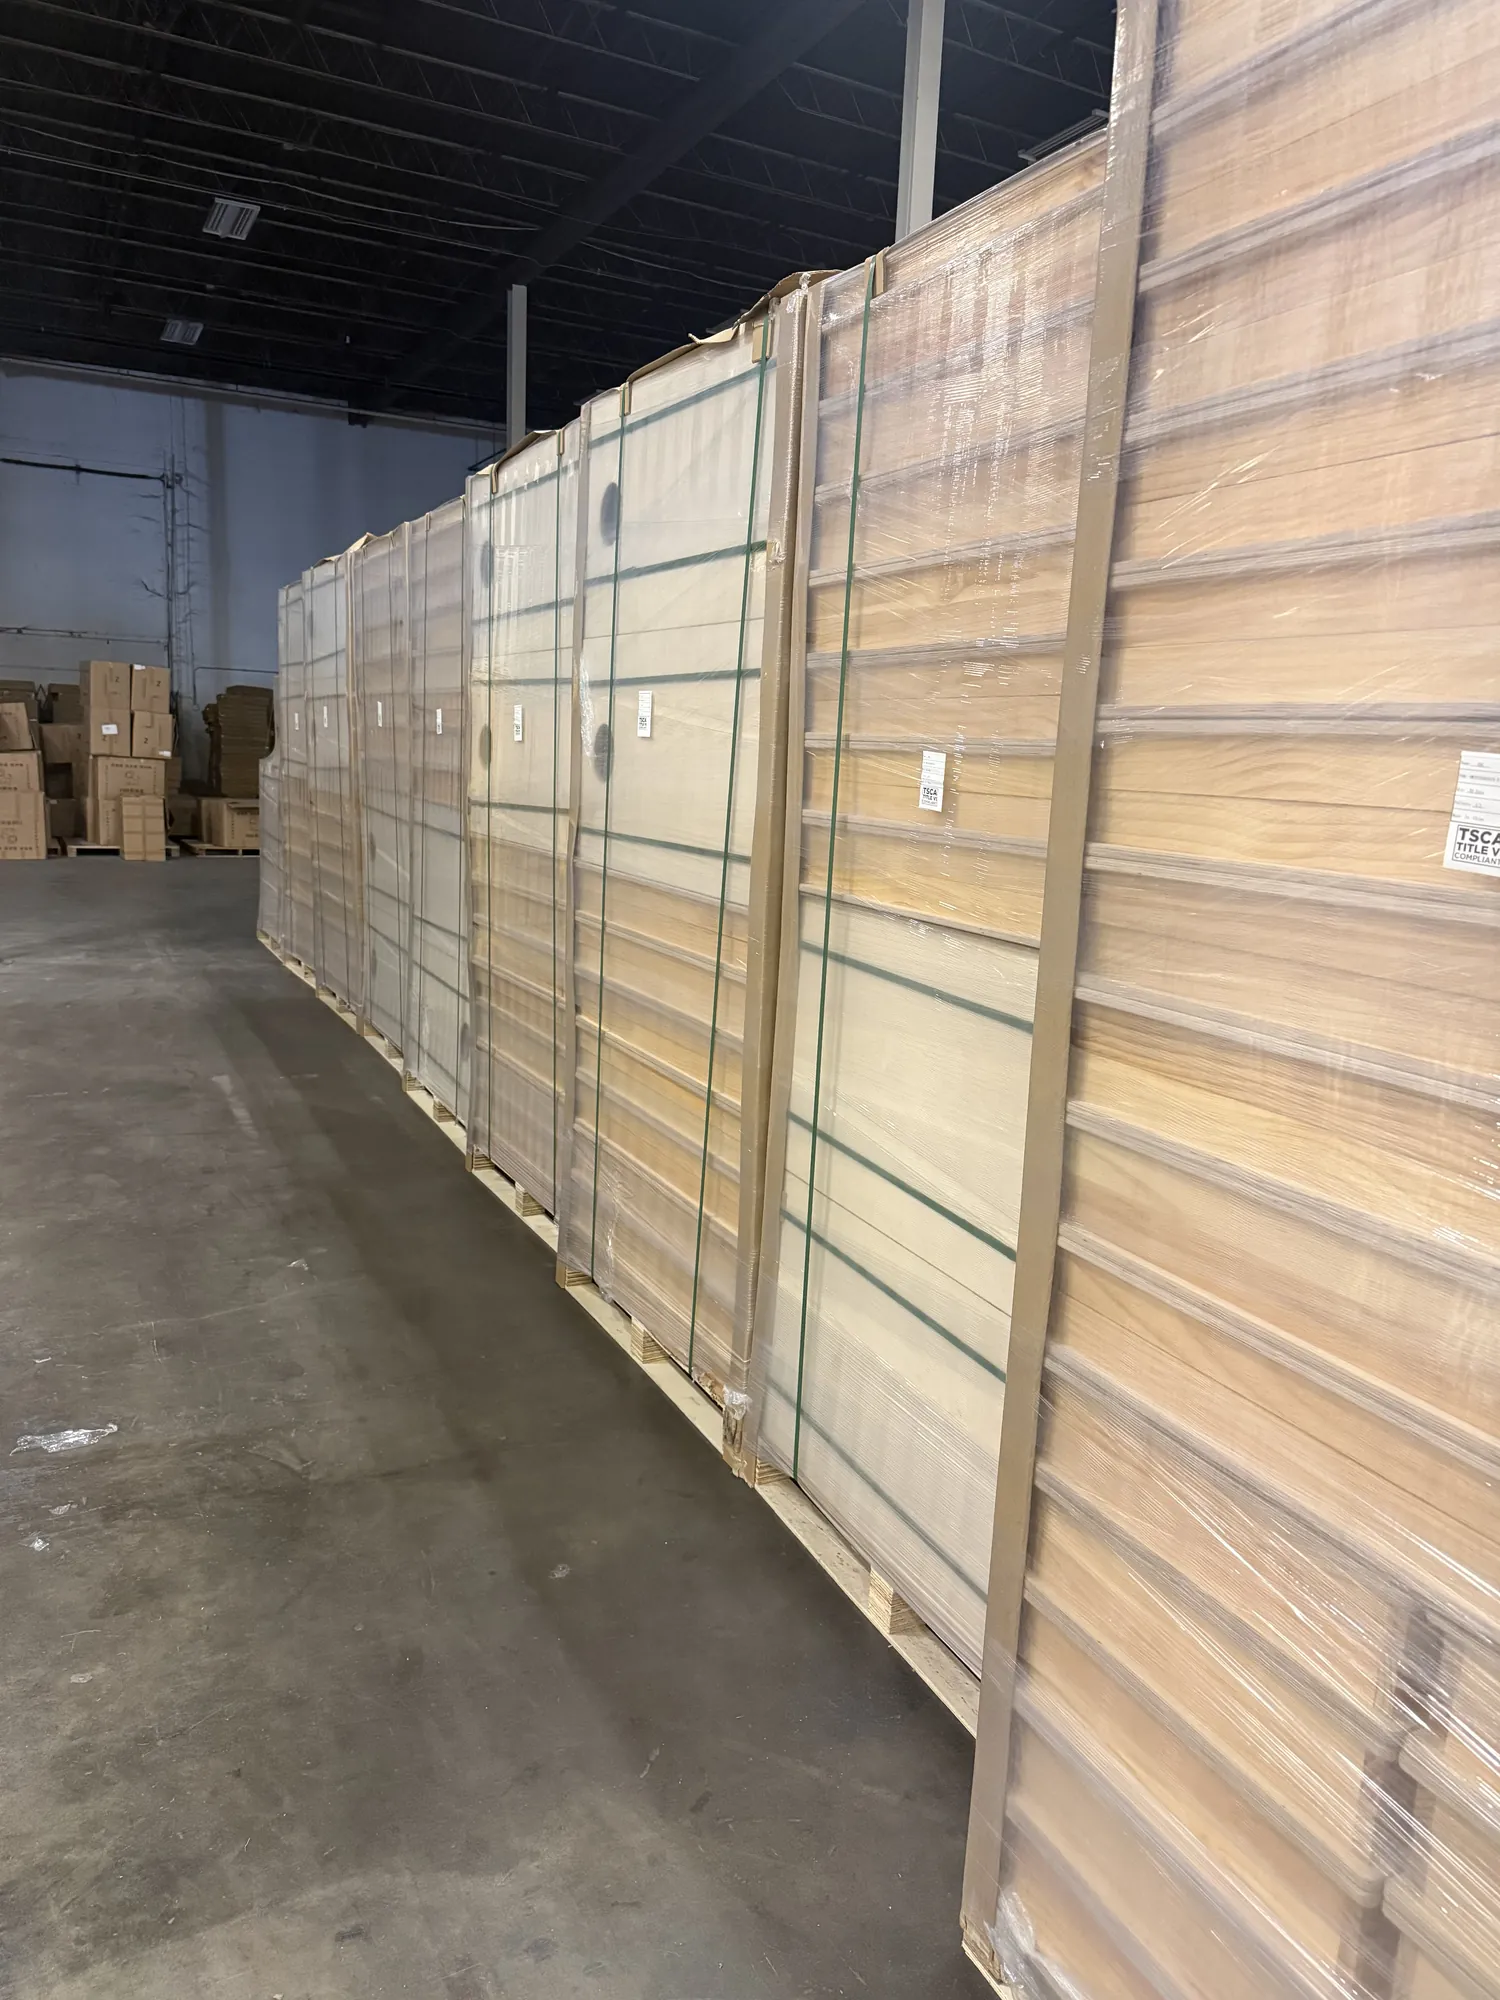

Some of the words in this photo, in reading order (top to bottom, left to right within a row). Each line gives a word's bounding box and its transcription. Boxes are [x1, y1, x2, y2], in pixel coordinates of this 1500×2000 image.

[923, 787, 937, 796] TSCA
[1459, 827, 1500, 845] TSCA
[1456, 841, 1489, 855] TITLE
